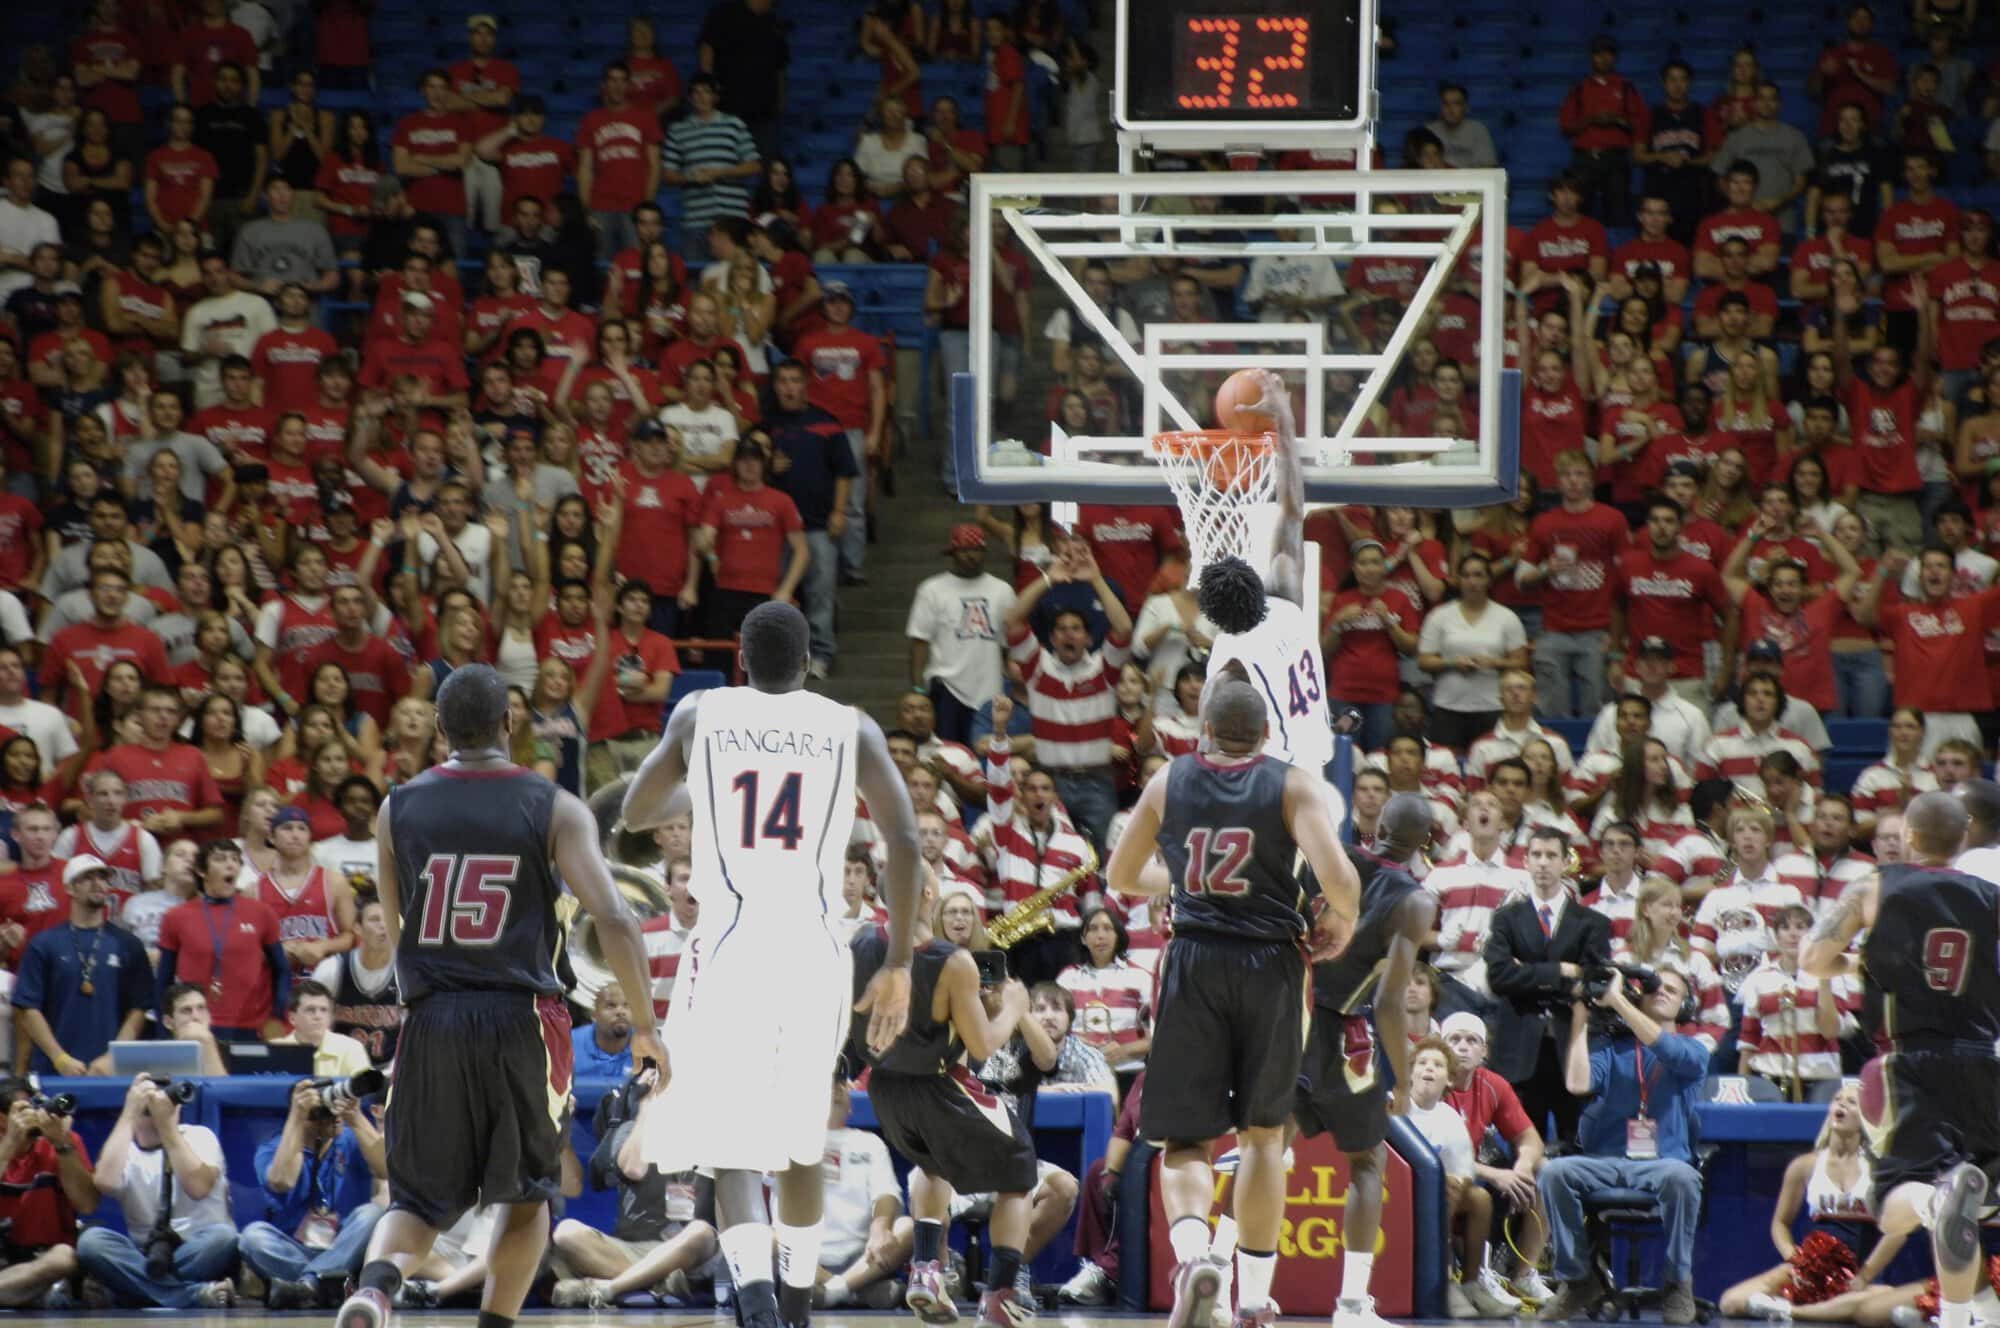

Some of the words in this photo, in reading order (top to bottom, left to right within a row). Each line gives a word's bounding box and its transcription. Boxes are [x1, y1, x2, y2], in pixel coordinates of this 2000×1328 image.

[1178, 16, 1309, 108] 32
[1288, 649, 1321, 718] 43
[712, 728, 833, 760] TANGARA
[732, 769, 803, 850] 14
[1184, 827, 1255, 897] 12
[418, 853, 521, 945] 15
[1922, 927, 1970, 997] 9
